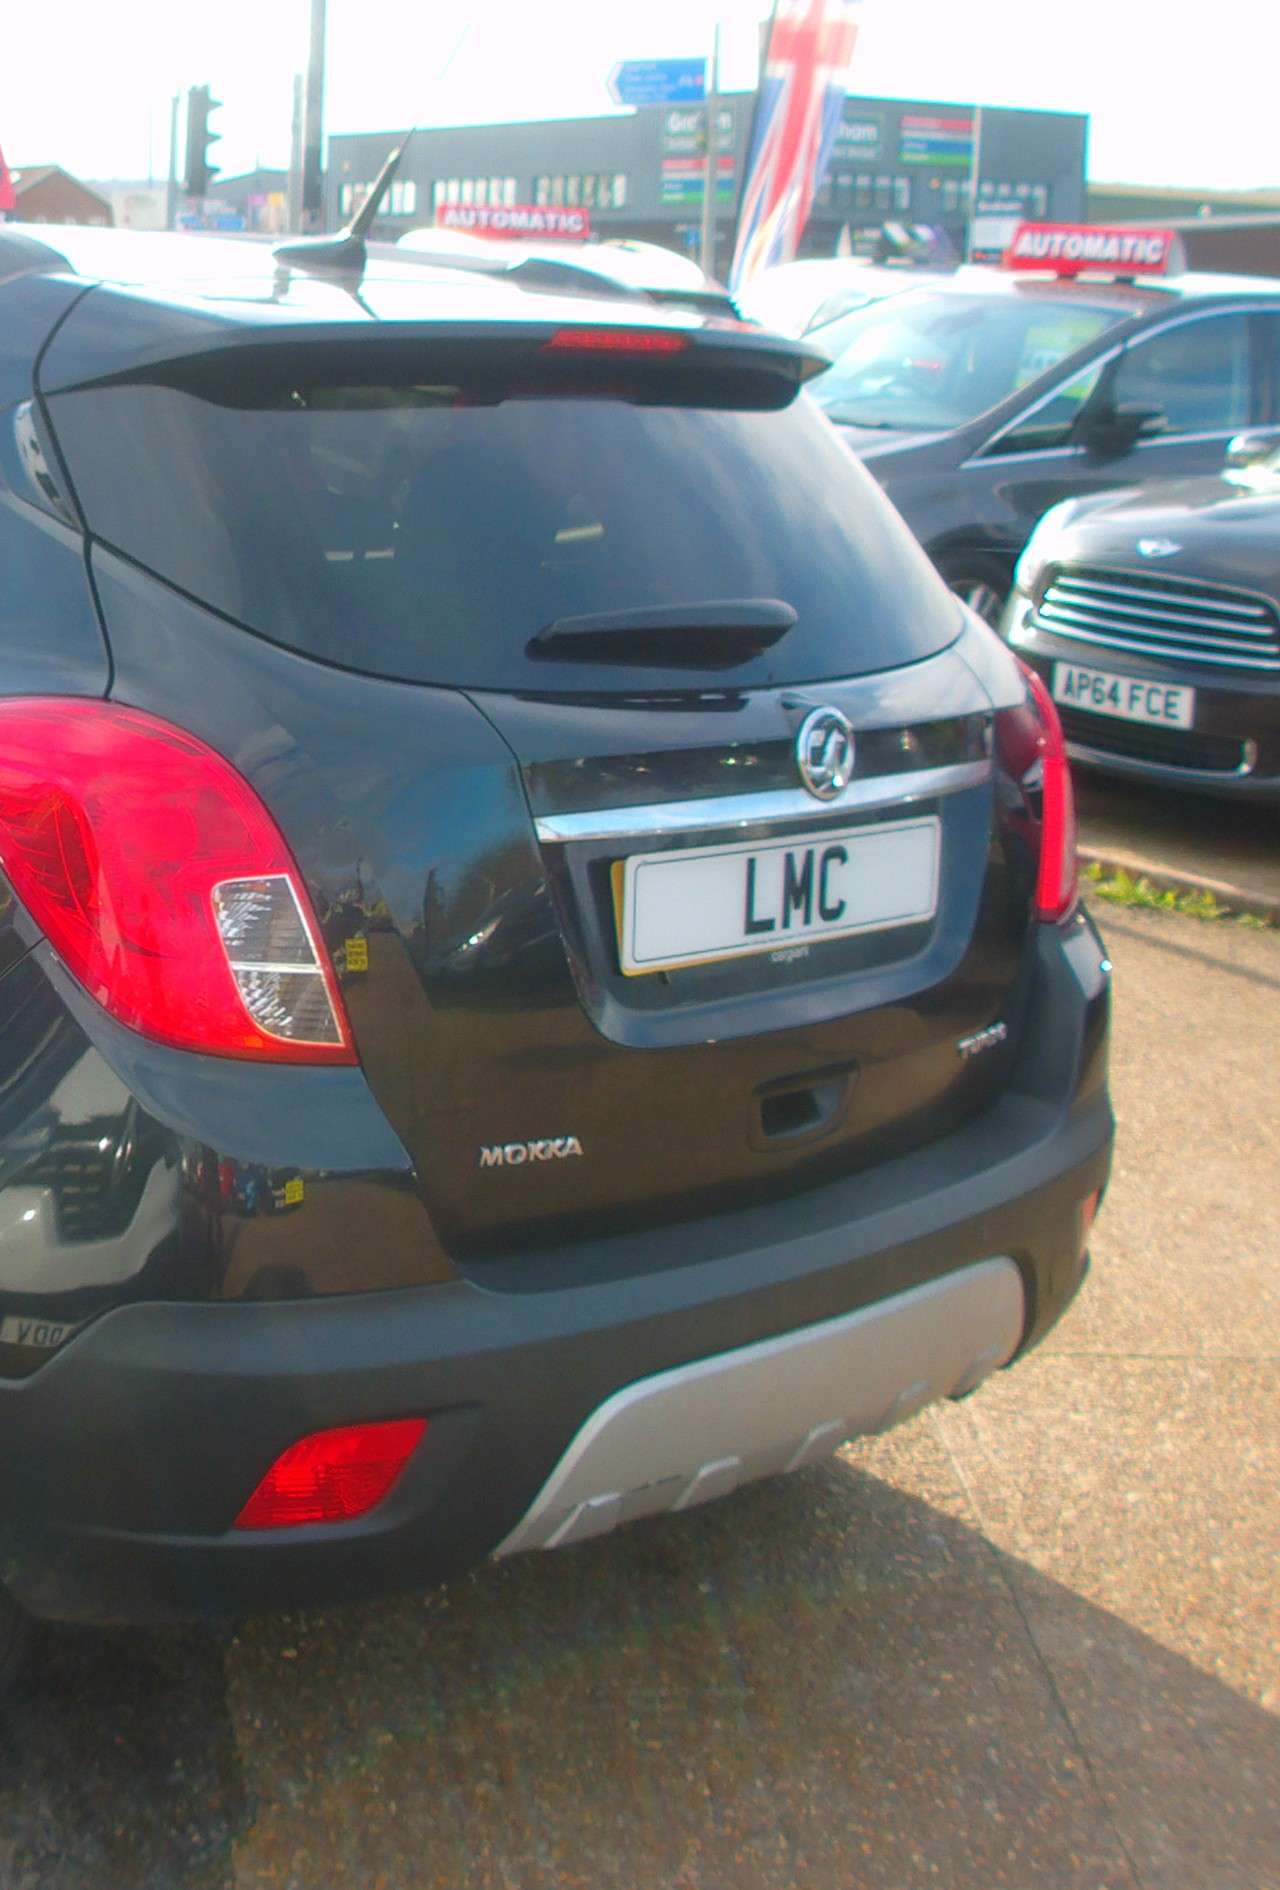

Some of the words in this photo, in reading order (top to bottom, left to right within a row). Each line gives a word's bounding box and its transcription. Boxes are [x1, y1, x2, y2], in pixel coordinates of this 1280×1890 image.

[444, 209, 584, 233] AUTOMATIC
[1017, 231, 1165, 263] AUTOMATIC
[1064, 669, 1120, 708] AP64
[1128, 683, 1182, 721] FCE
[743, 845, 849, 936] LMC
[479, 1136, 584, 1168] MOKKA
